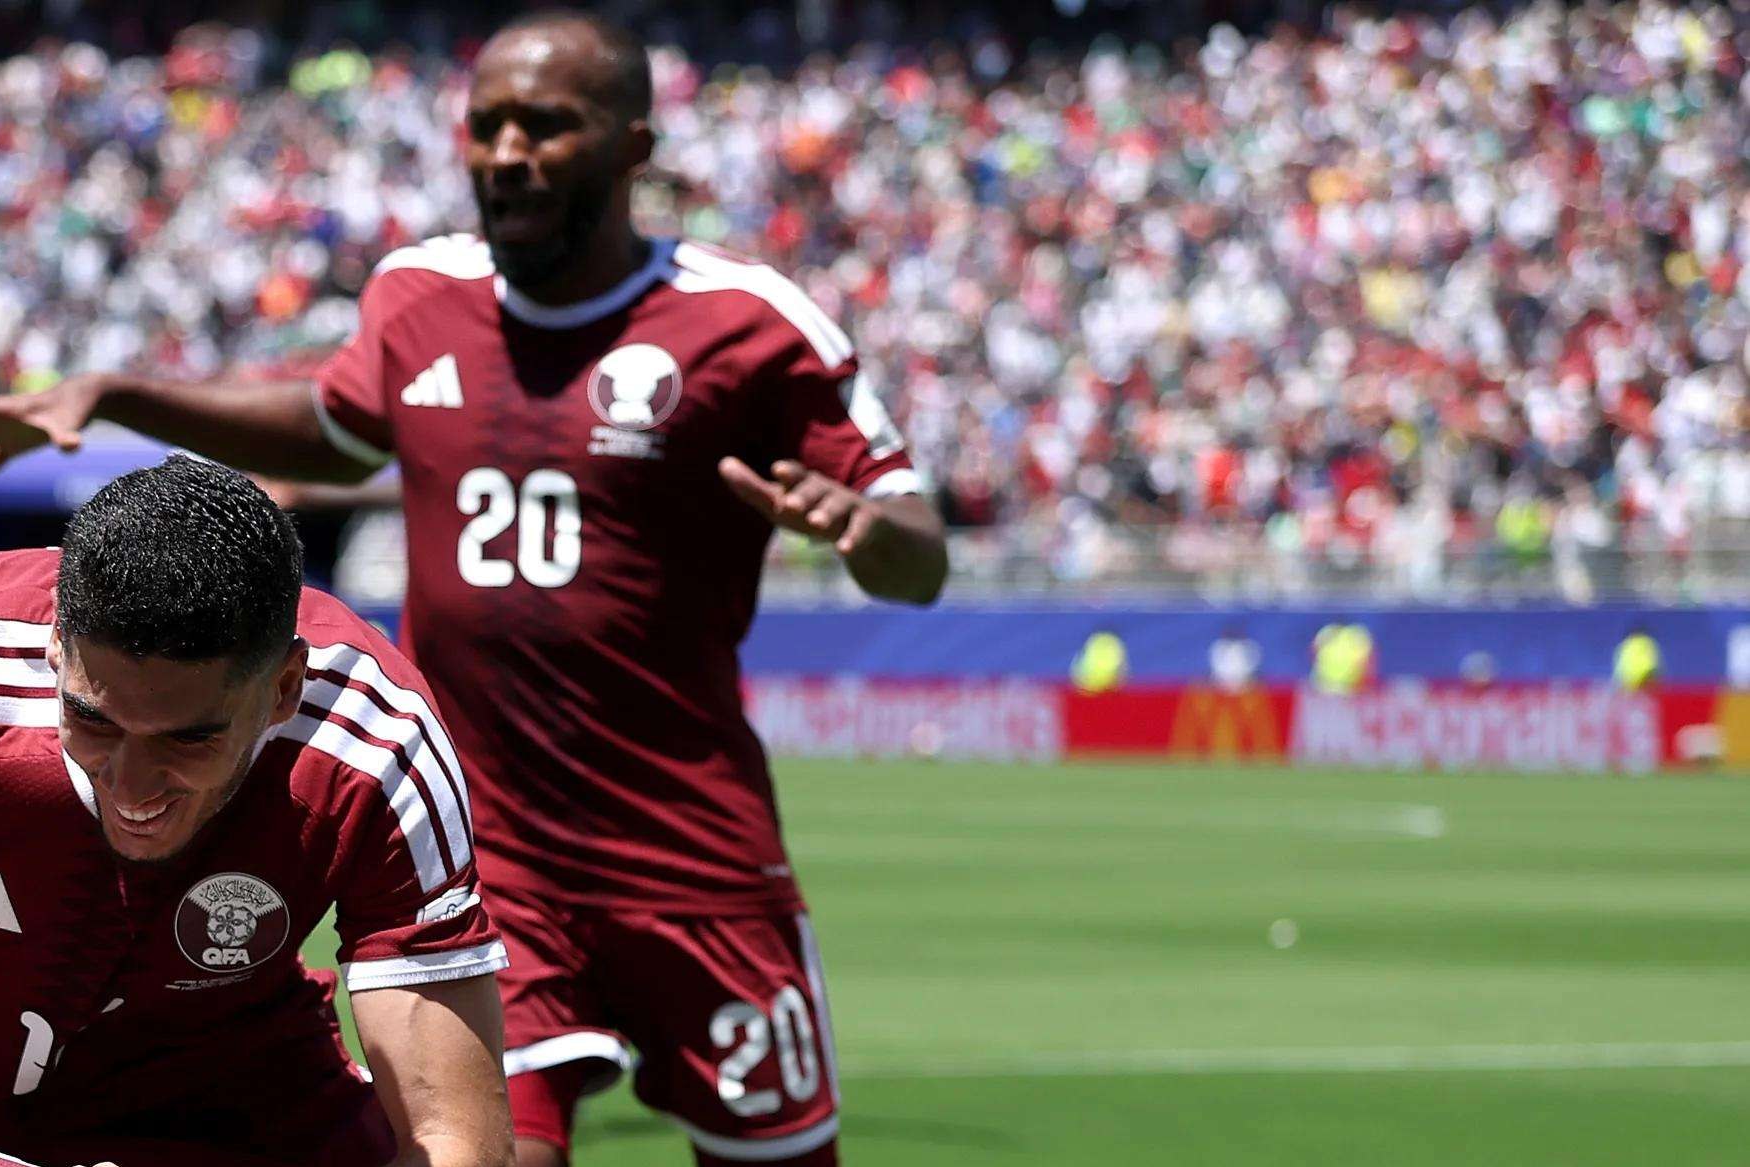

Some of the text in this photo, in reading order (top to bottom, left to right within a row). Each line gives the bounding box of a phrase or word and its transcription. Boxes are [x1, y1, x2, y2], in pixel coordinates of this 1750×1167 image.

[456, 466, 582, 588] 20
[202, 947, 250, 965] QFA
[709, 984, 820, 1117] 20
